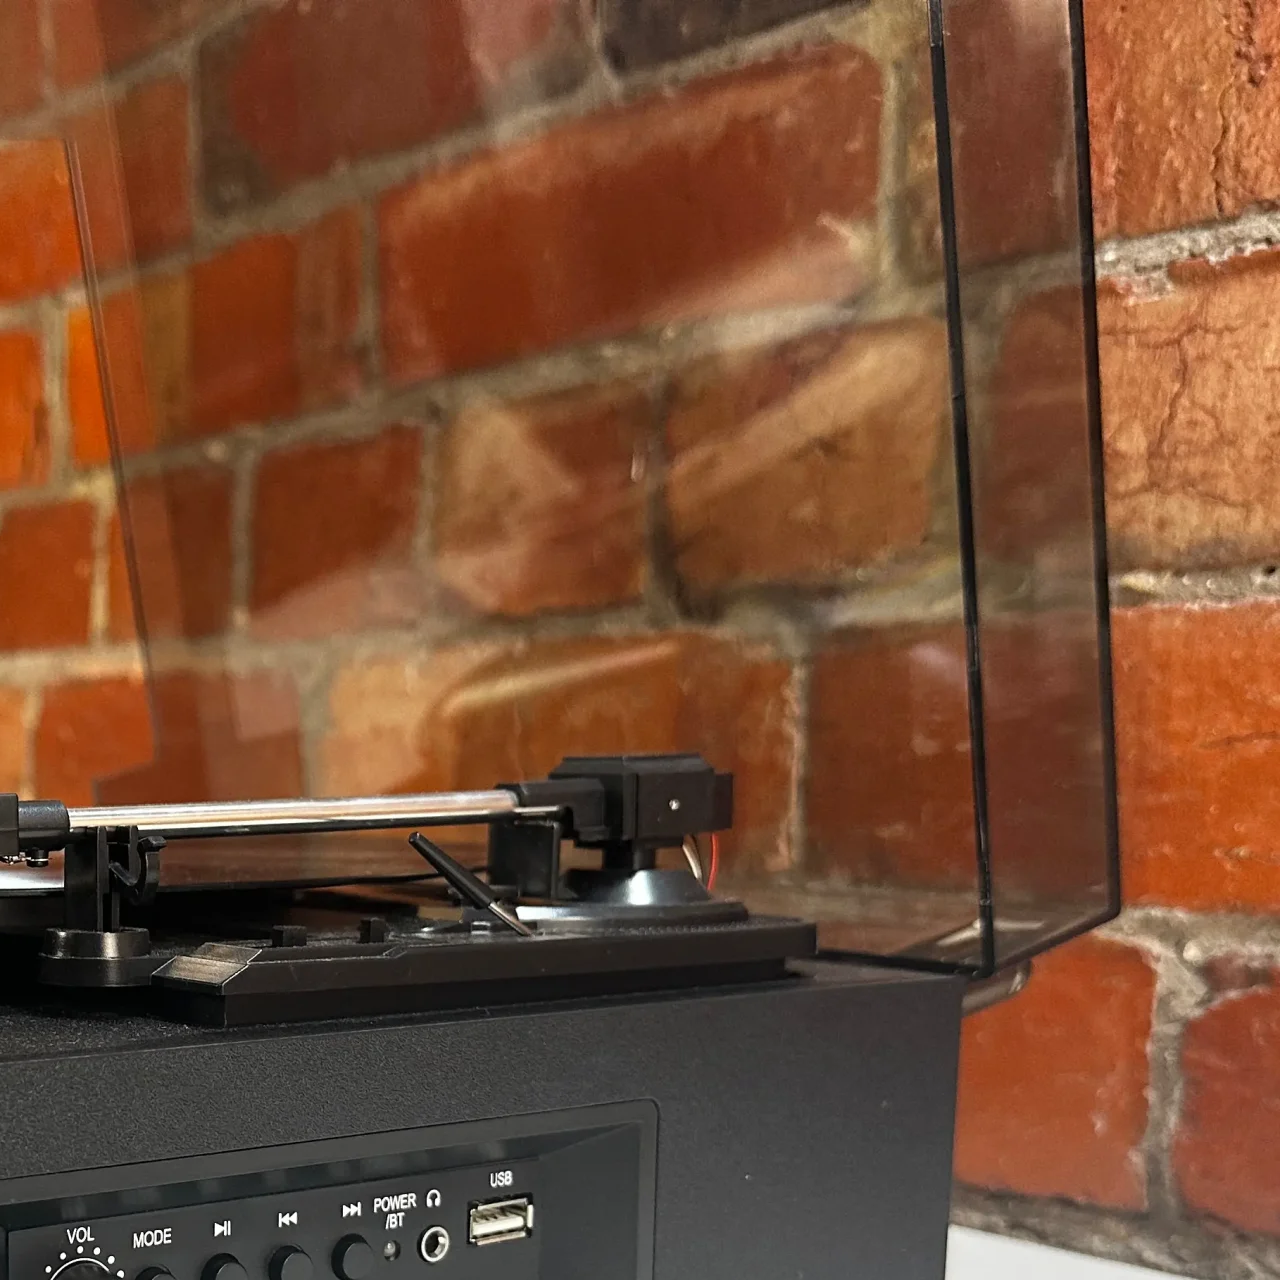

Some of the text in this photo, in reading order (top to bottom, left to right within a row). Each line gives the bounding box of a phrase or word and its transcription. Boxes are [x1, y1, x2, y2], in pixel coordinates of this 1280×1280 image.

[490, 1170, 513, 1188] USB
[373, 1193, 417, 1213] POWER
[385, 1212, 405, 1230] /BT
[66, 1226, 95, 1244] VOL
[133, 1227, 172, 1249] MODE
